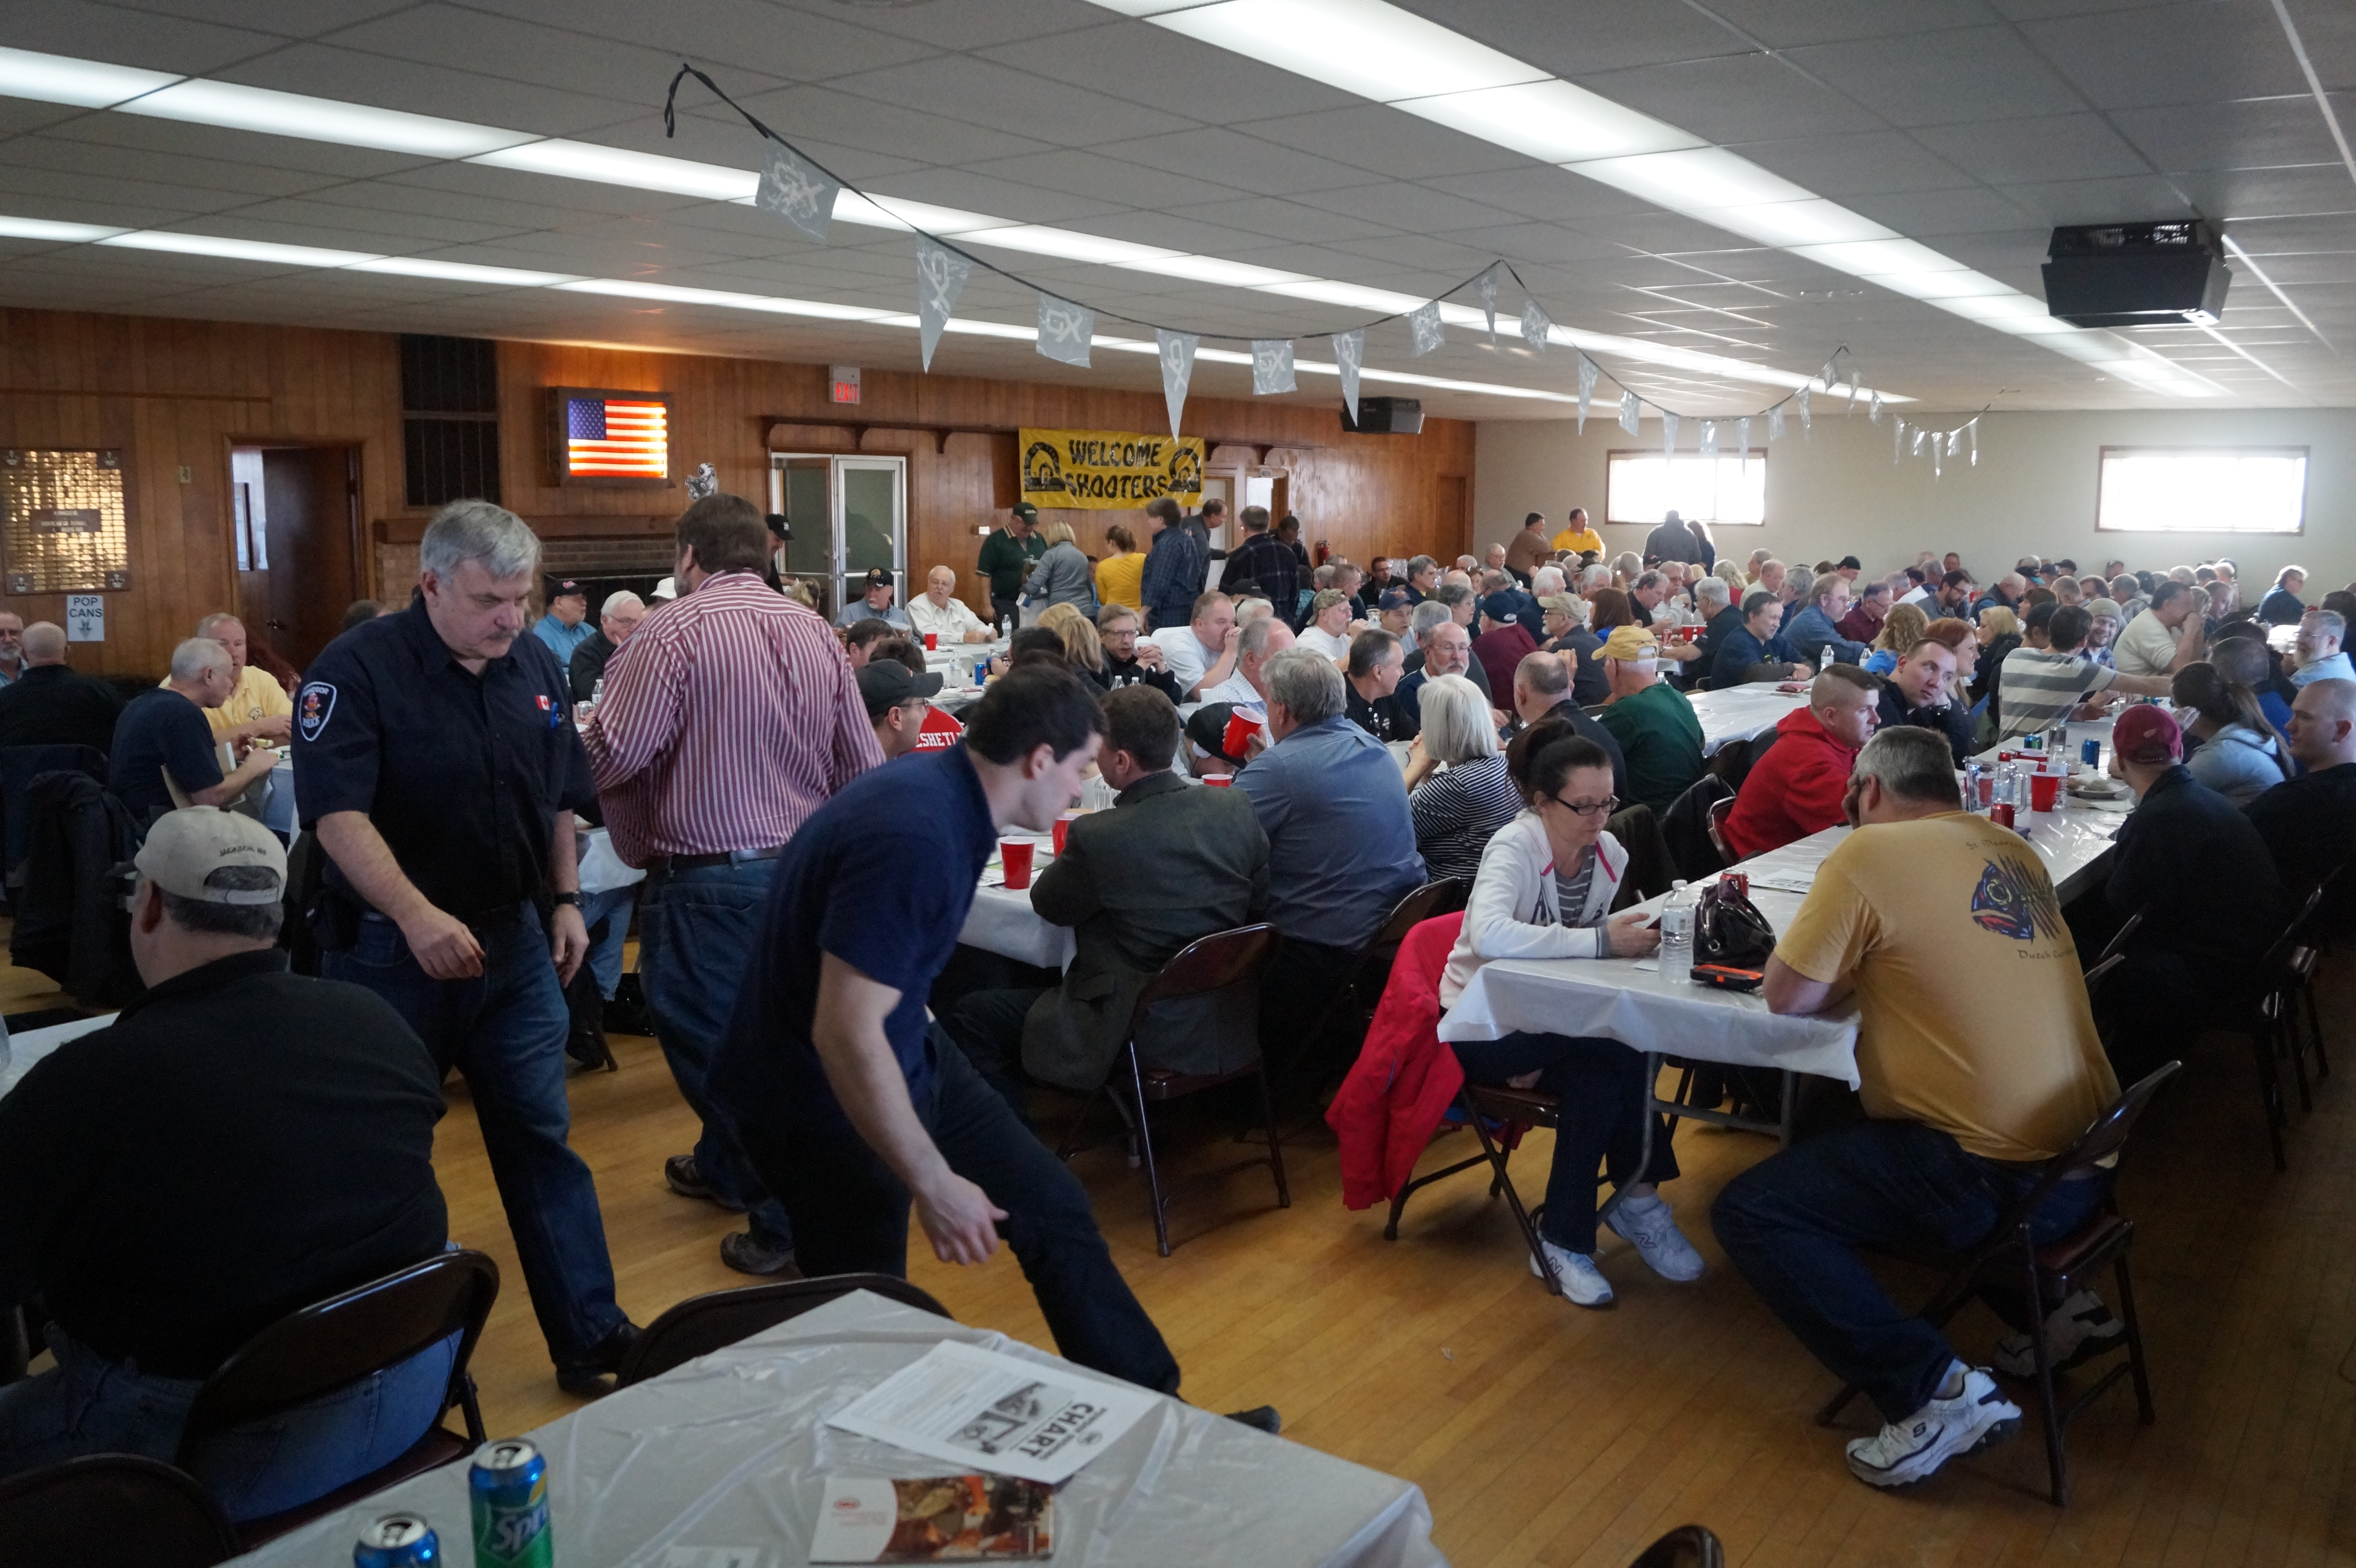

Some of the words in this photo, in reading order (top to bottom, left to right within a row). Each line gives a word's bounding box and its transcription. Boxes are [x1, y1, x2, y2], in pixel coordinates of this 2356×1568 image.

[836, 383, 858, 402] EXIT
[1069, 439, 1162, 467] WELCOME
[1065, 472, 1168, 499] SHOOTERS
[69, 608, 103, 617] CANS
[73, 597, 98, 606] POP
[1018, 1404, 1094, 1458] CHART
